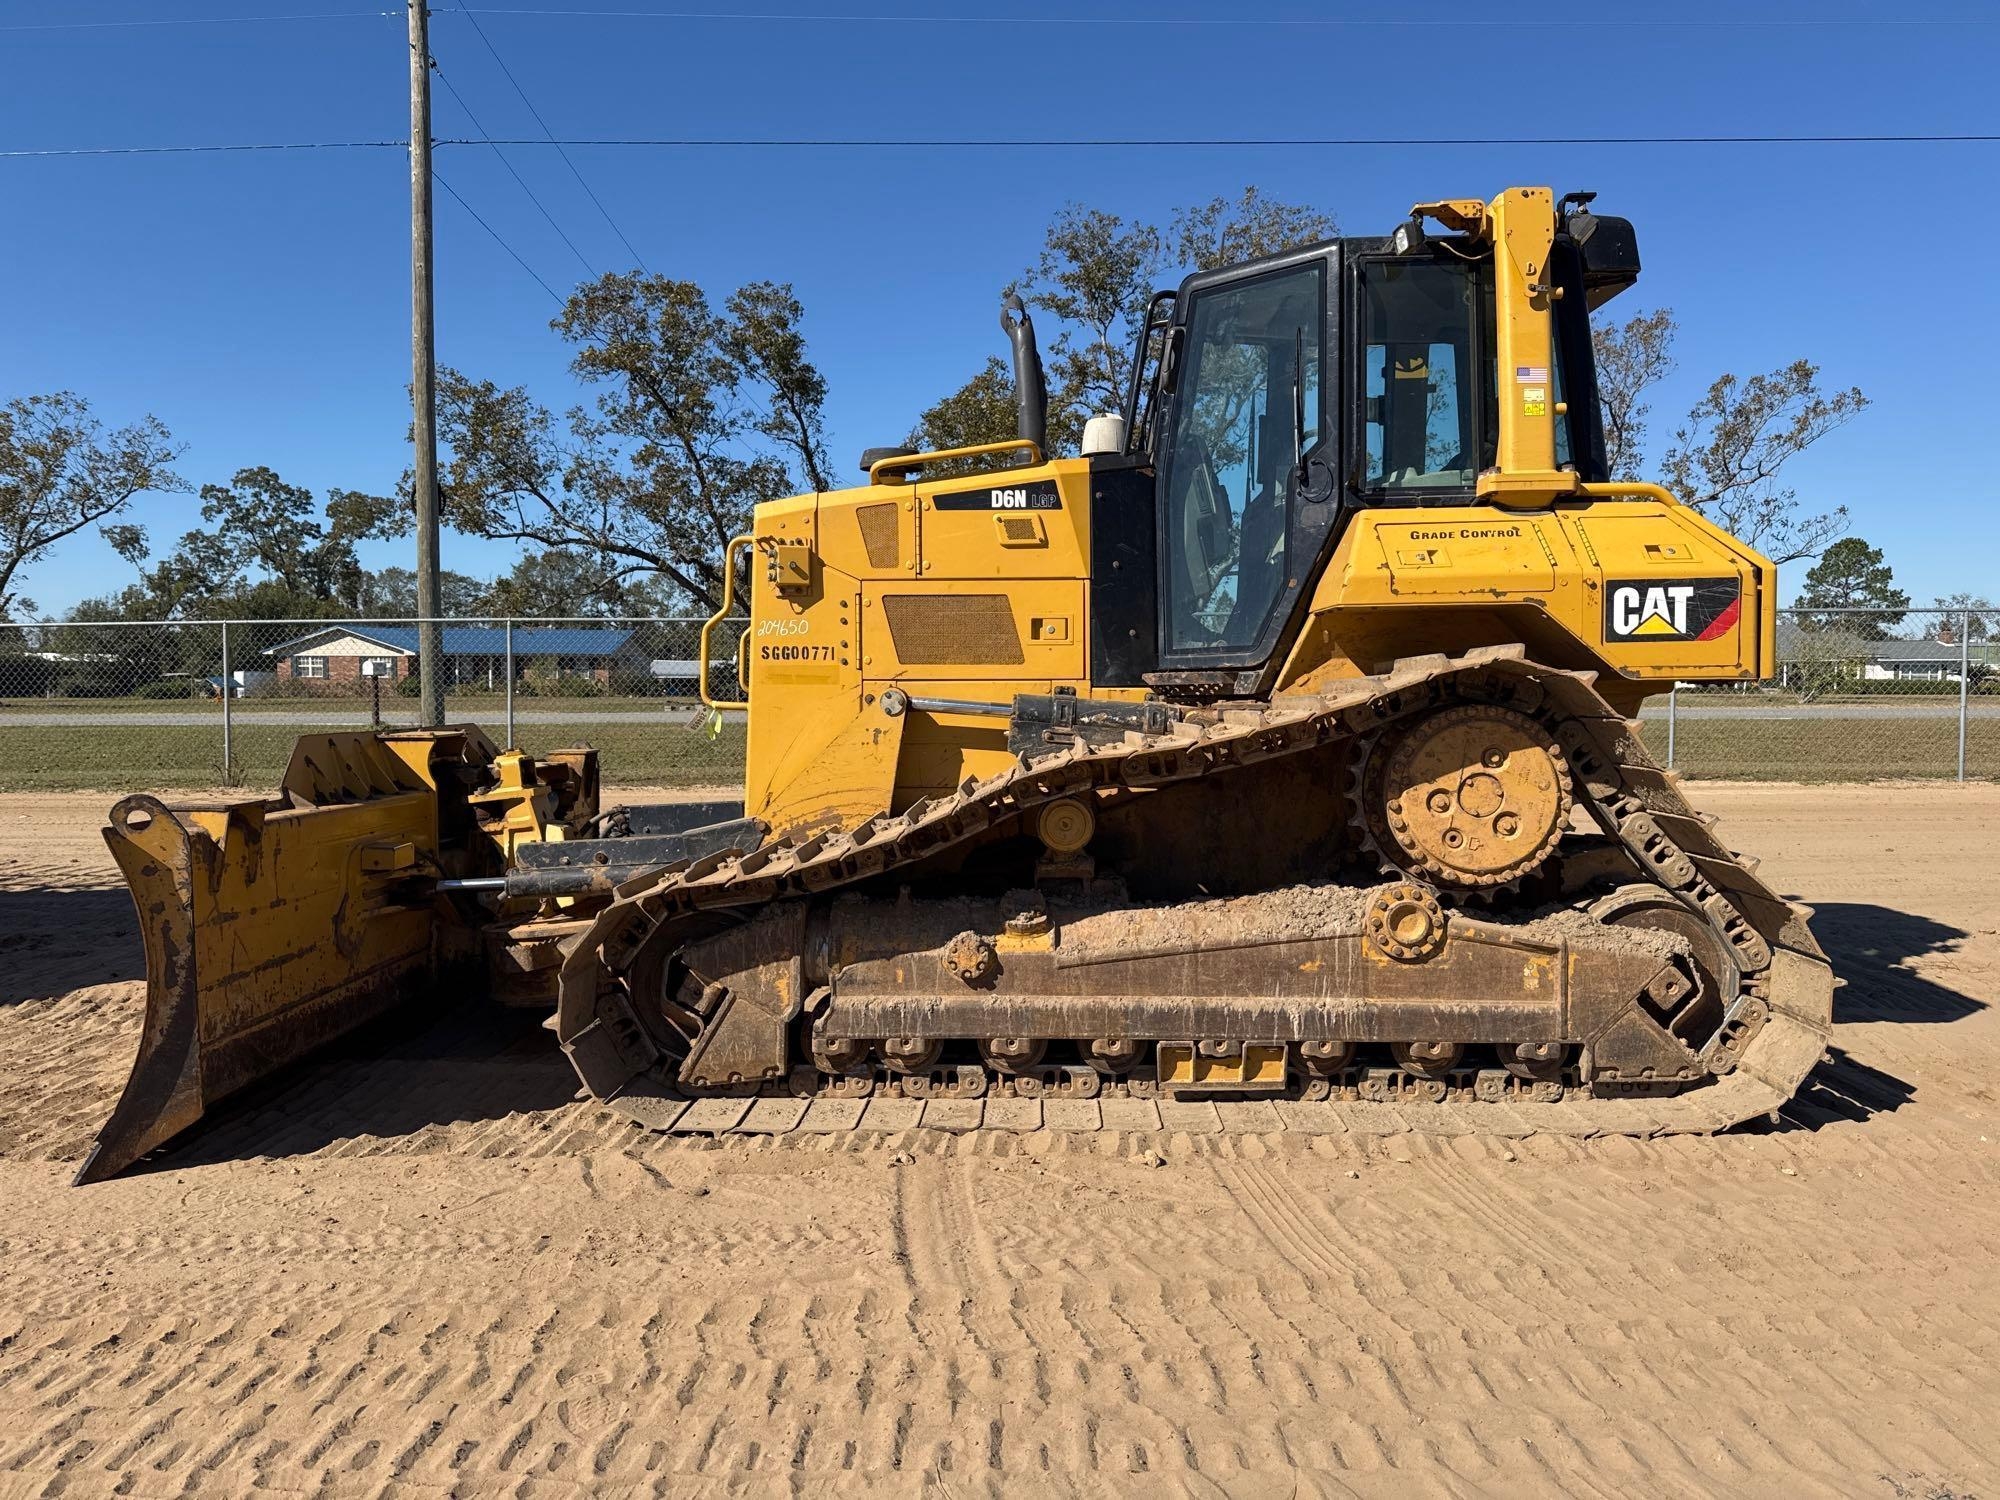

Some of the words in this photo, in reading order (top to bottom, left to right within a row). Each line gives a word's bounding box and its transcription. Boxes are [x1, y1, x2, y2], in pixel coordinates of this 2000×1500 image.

[991, 489, 1026, 508] D6N
[1031, 494, 1057, 508] LGP
[1410, 530, 1455, 540] GRADE
[1613, 586, 1694, 635] CAT
[757, 619, 809, 636] 204650
[761, 645, 835, 661] SGG00771
